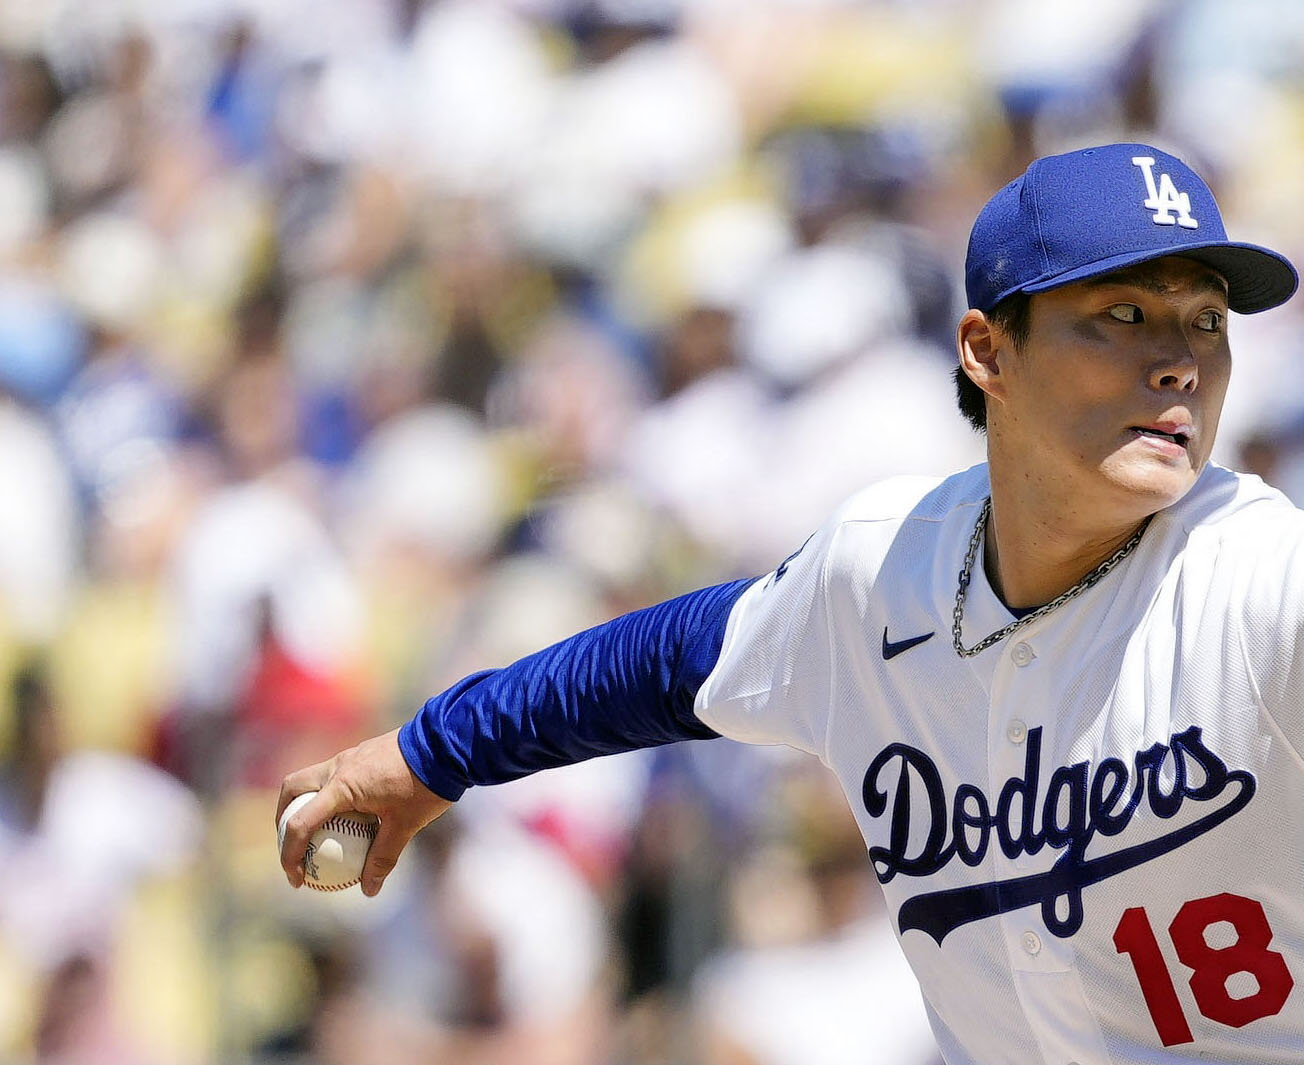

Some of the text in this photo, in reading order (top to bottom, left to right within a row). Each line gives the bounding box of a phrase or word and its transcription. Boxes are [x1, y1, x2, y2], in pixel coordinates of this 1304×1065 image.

[1131, 156, 1199, 230] LA
[862, 725, 1257, 940] Dodgers
[1112, 892, 1295, 1048] 18
